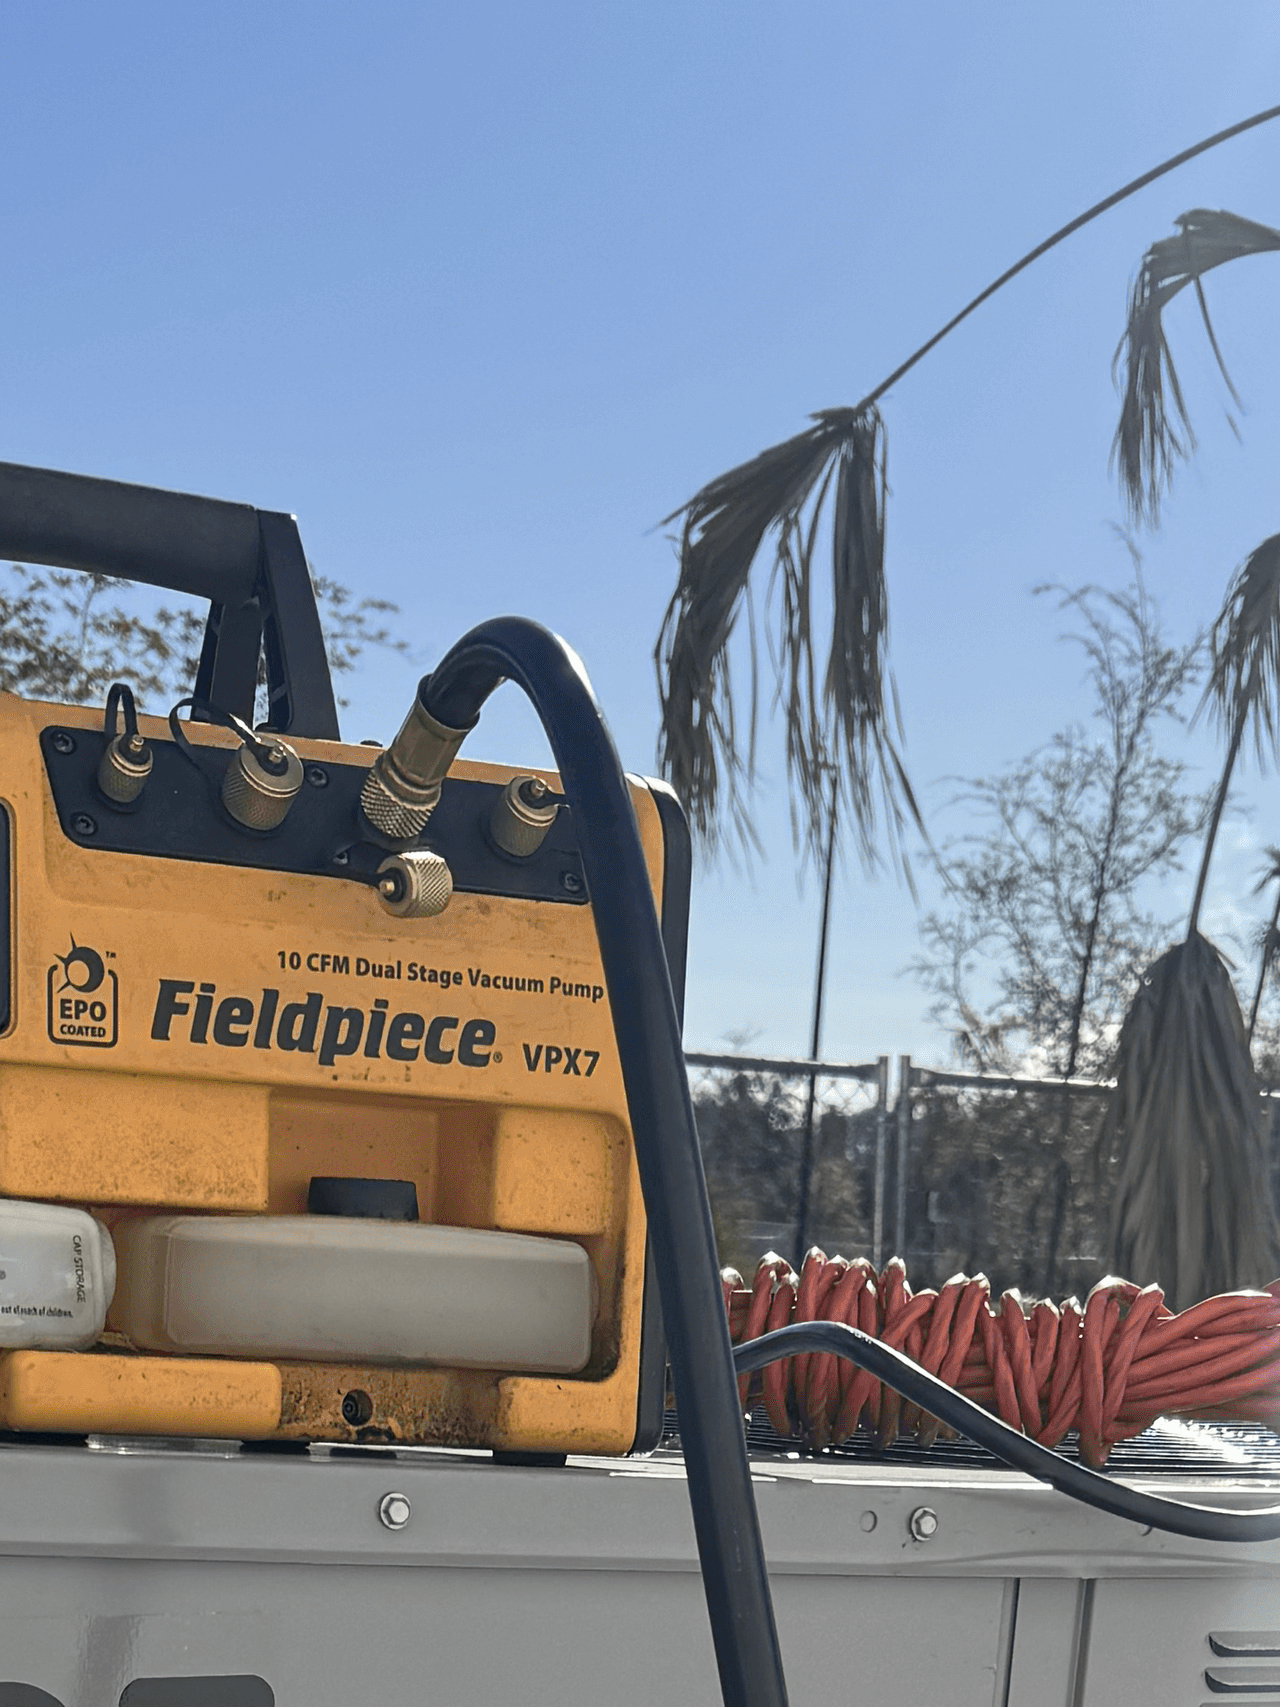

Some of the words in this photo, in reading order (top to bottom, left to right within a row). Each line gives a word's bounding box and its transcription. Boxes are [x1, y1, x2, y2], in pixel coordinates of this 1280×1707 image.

[277, 951, 301, 971] 10
[306, 953, 350, 976] CFM
[356, 957, 402, 980] Dual
[407, 961, 463, 989] Stage
[468, 969, 545, 994] Vacuum
[550, 976, 604, 1003] Pump
[59, 998, 107, 1022] EPO
[150, 978, 498, 1067] Fieldpiece
[522, 1043, 601, 1078] VPX7
[59, 1024, 107, 1040] COATED
